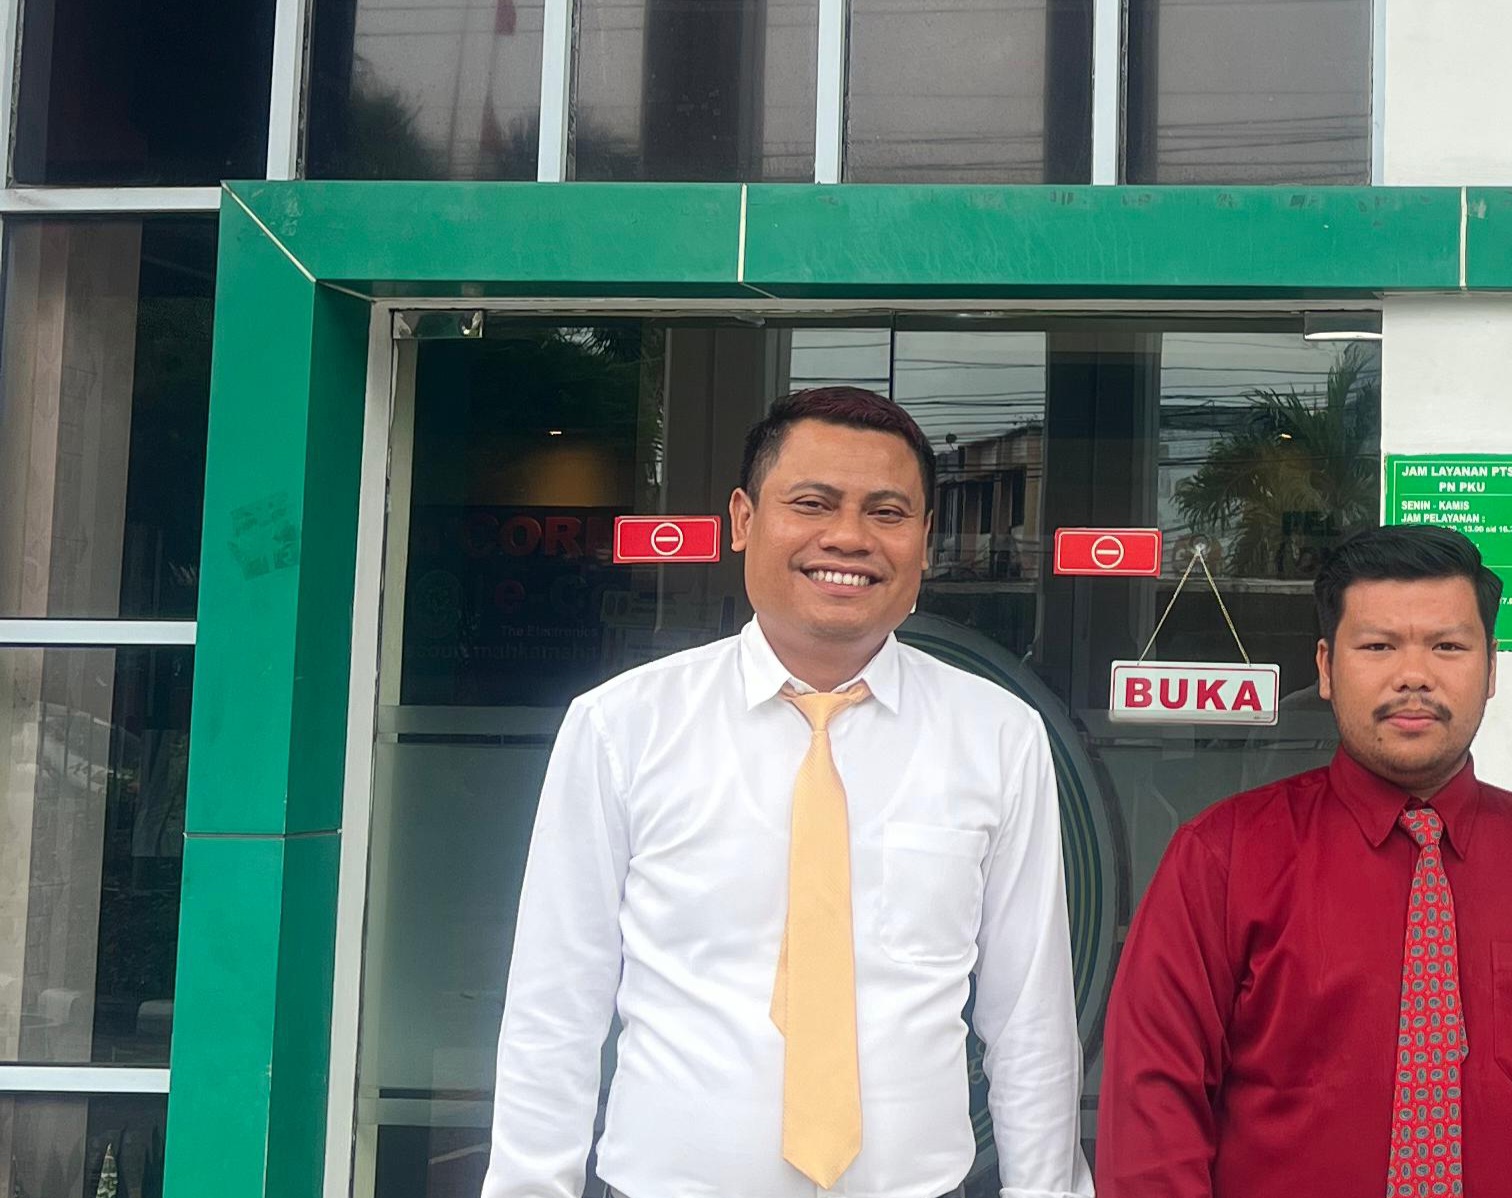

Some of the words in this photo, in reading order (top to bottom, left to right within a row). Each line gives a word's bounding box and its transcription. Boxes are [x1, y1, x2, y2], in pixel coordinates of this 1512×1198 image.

[1401, 466, 1428, 477] JAM
[1431, 466, 1488, 477] LAYANAN
[1439, 482, 1456, 493] PN
[1460, 482, 1486, 493] PKU
[1401, 501, 1431, 510] SENIN
[1439, 501, 1470, 510] KAMIS
[1401, 513, 1421, 523] JAM
[1424, 513, 1480, 523] PELAYANAN
[1125, 677, 1262, 711] BUKA
